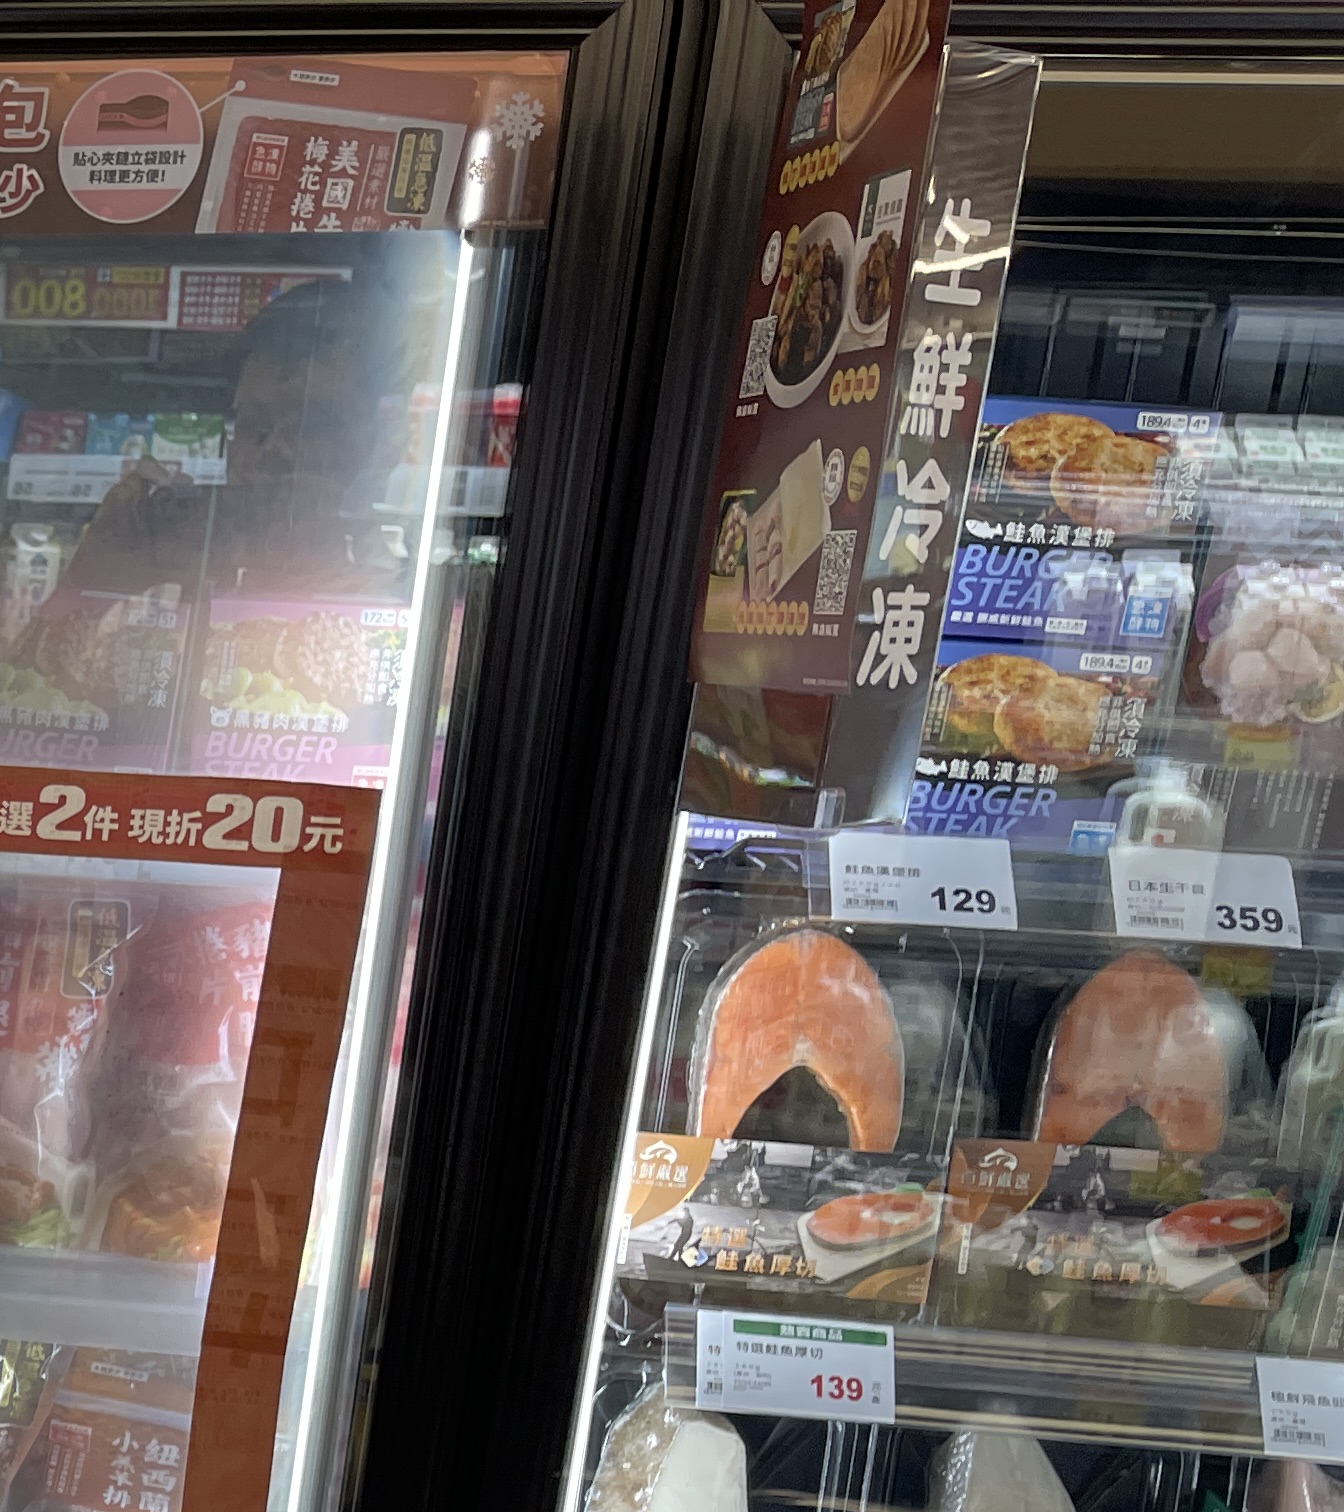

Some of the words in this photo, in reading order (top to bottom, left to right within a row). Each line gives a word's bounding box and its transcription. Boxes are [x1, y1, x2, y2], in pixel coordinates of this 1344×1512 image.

[855, 197, 993, 690] 生鮮冷凍
[1004, 521, 1116, 548] 鮭魚漢堡排
[205, 732, 338, 764] BURGER
[947, 759, 1060, 786] 鮭魚漢堡排
[909, 780, 1058, 818] BURGER
[127, 793, 345, 856] 現折20元
[929, 885, 997, 914] 129
[1214, 904, 1284, 934] 359
[735, 1340, 825, 1361] 特選鮭魚厚切
[810, 1373, 864, 1403] 139
